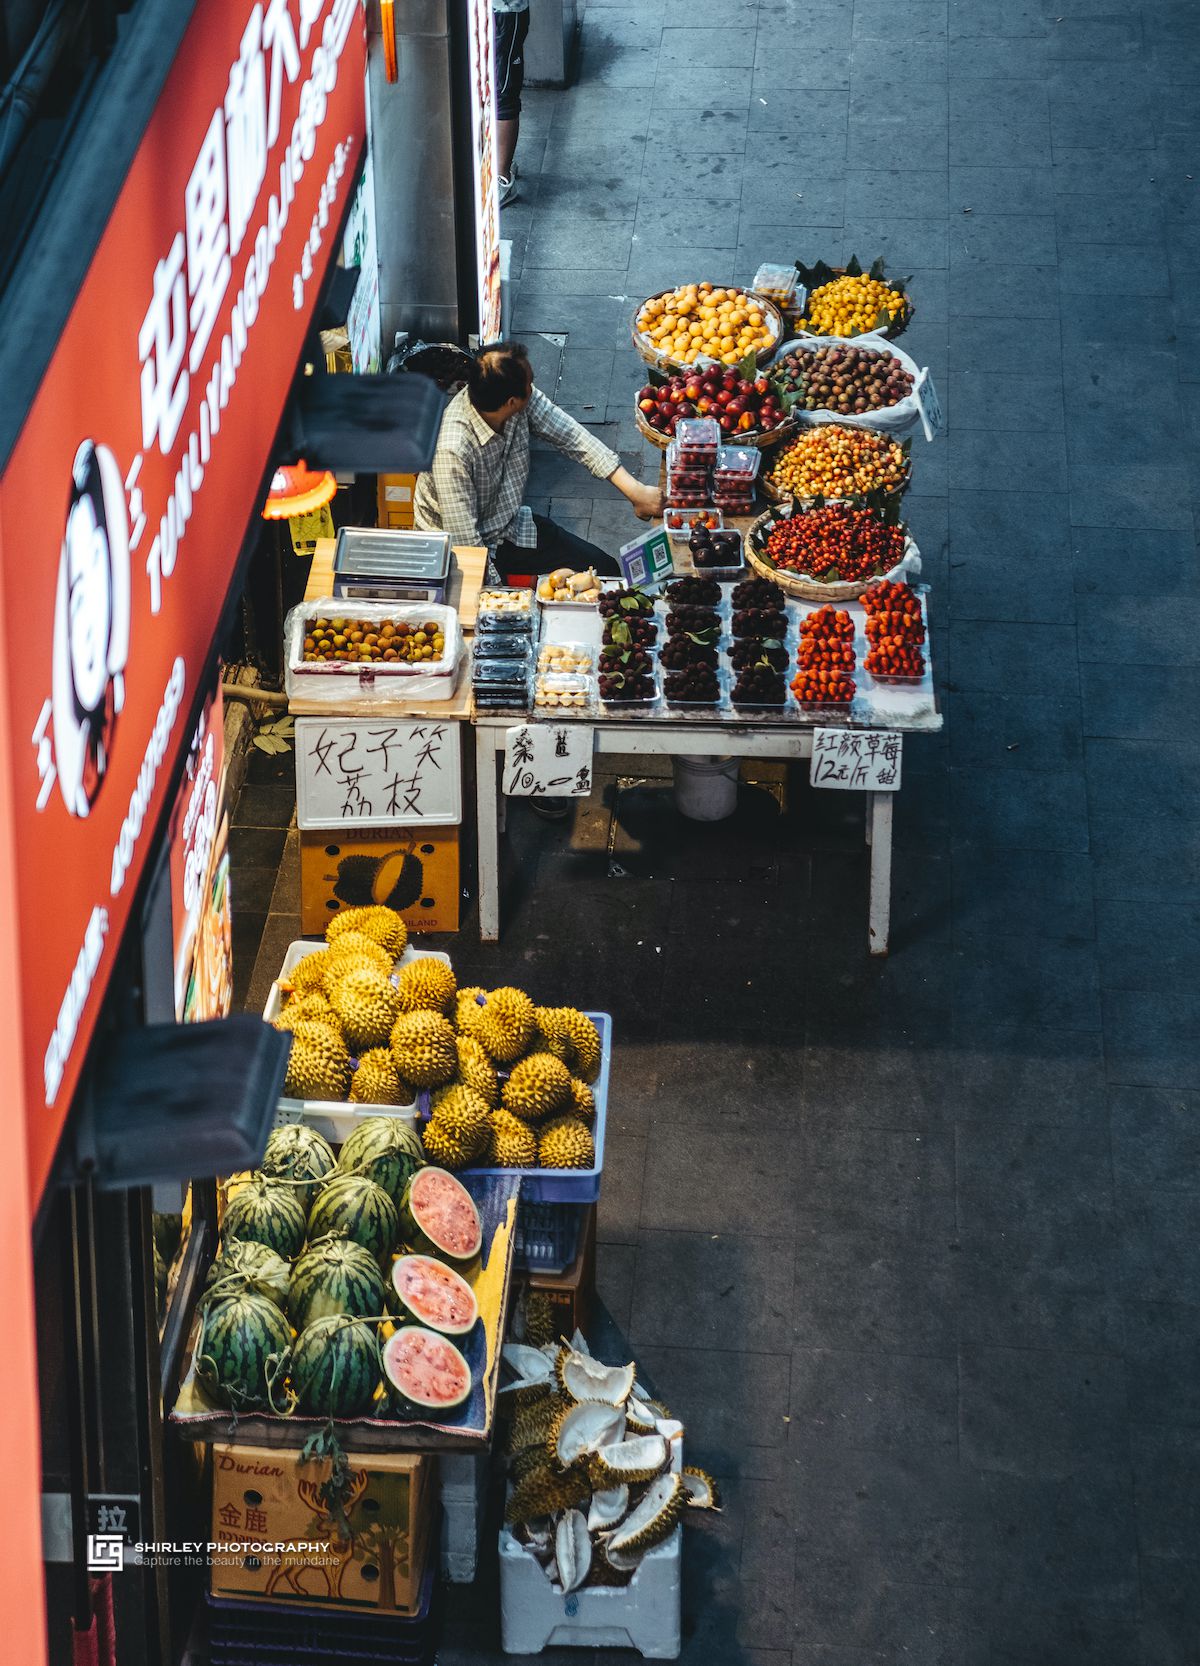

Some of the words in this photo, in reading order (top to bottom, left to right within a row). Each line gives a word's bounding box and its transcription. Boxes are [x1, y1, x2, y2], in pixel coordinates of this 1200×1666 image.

[308, 725, 448, 777] 妃子笑
[814, 732, 903, 769] 红颜草莓
[876, 768, 898, 785] 甜
[337, 771, 424, 818] 荔枝
[346, 828, 416, 840] DURIAN
[218, 1455, 284, 1477] Durian
[97, 1505, 128, 1532] 拉
[219, 1502, 268, 1534] 金鹿
